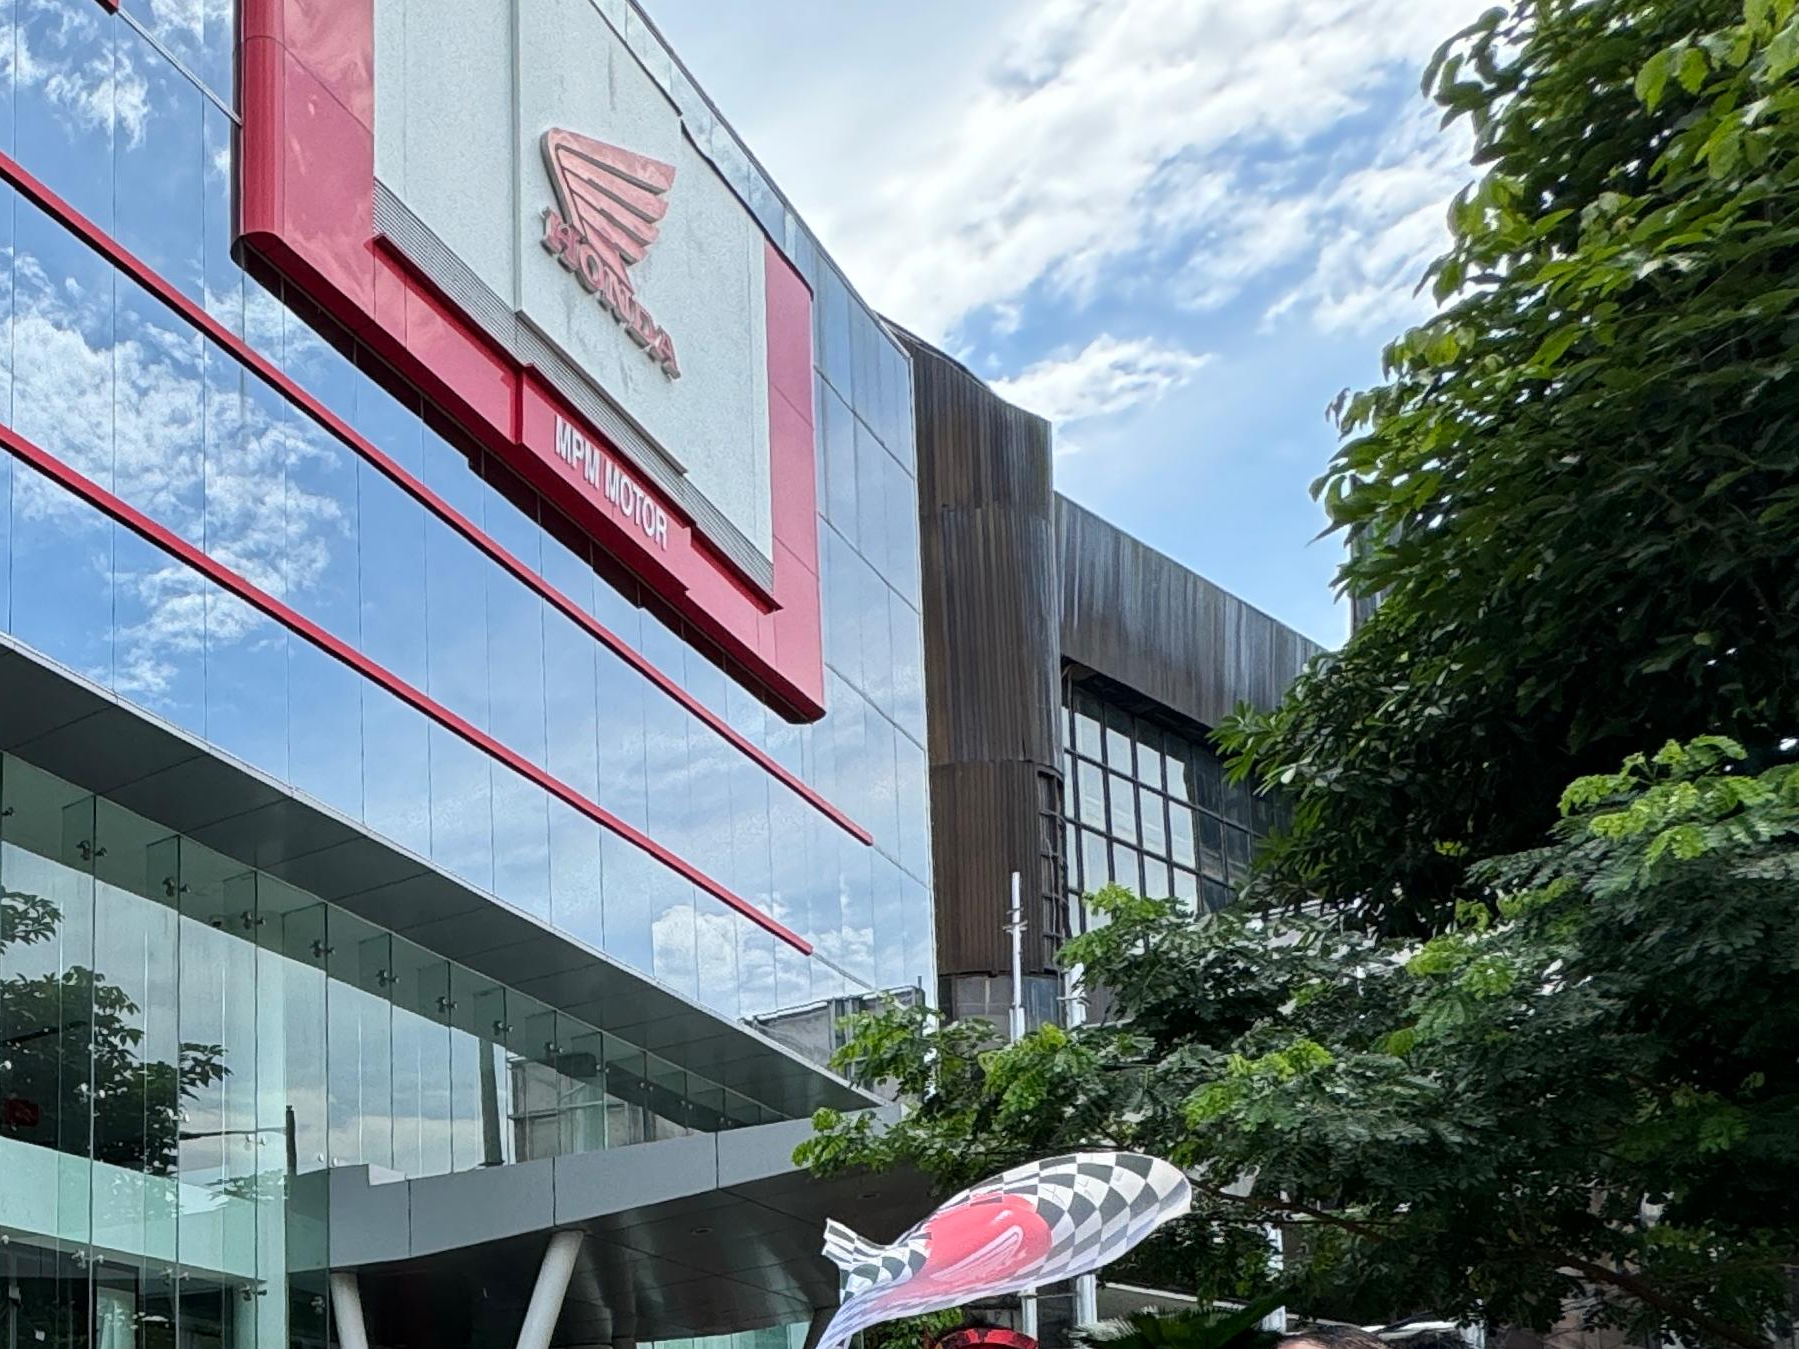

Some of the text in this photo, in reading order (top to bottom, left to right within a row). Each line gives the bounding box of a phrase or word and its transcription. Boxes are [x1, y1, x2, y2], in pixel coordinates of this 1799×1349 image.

[540, 206, 681, 382] HONDA
[554, 413, 668, 550] MPM MOTOR
